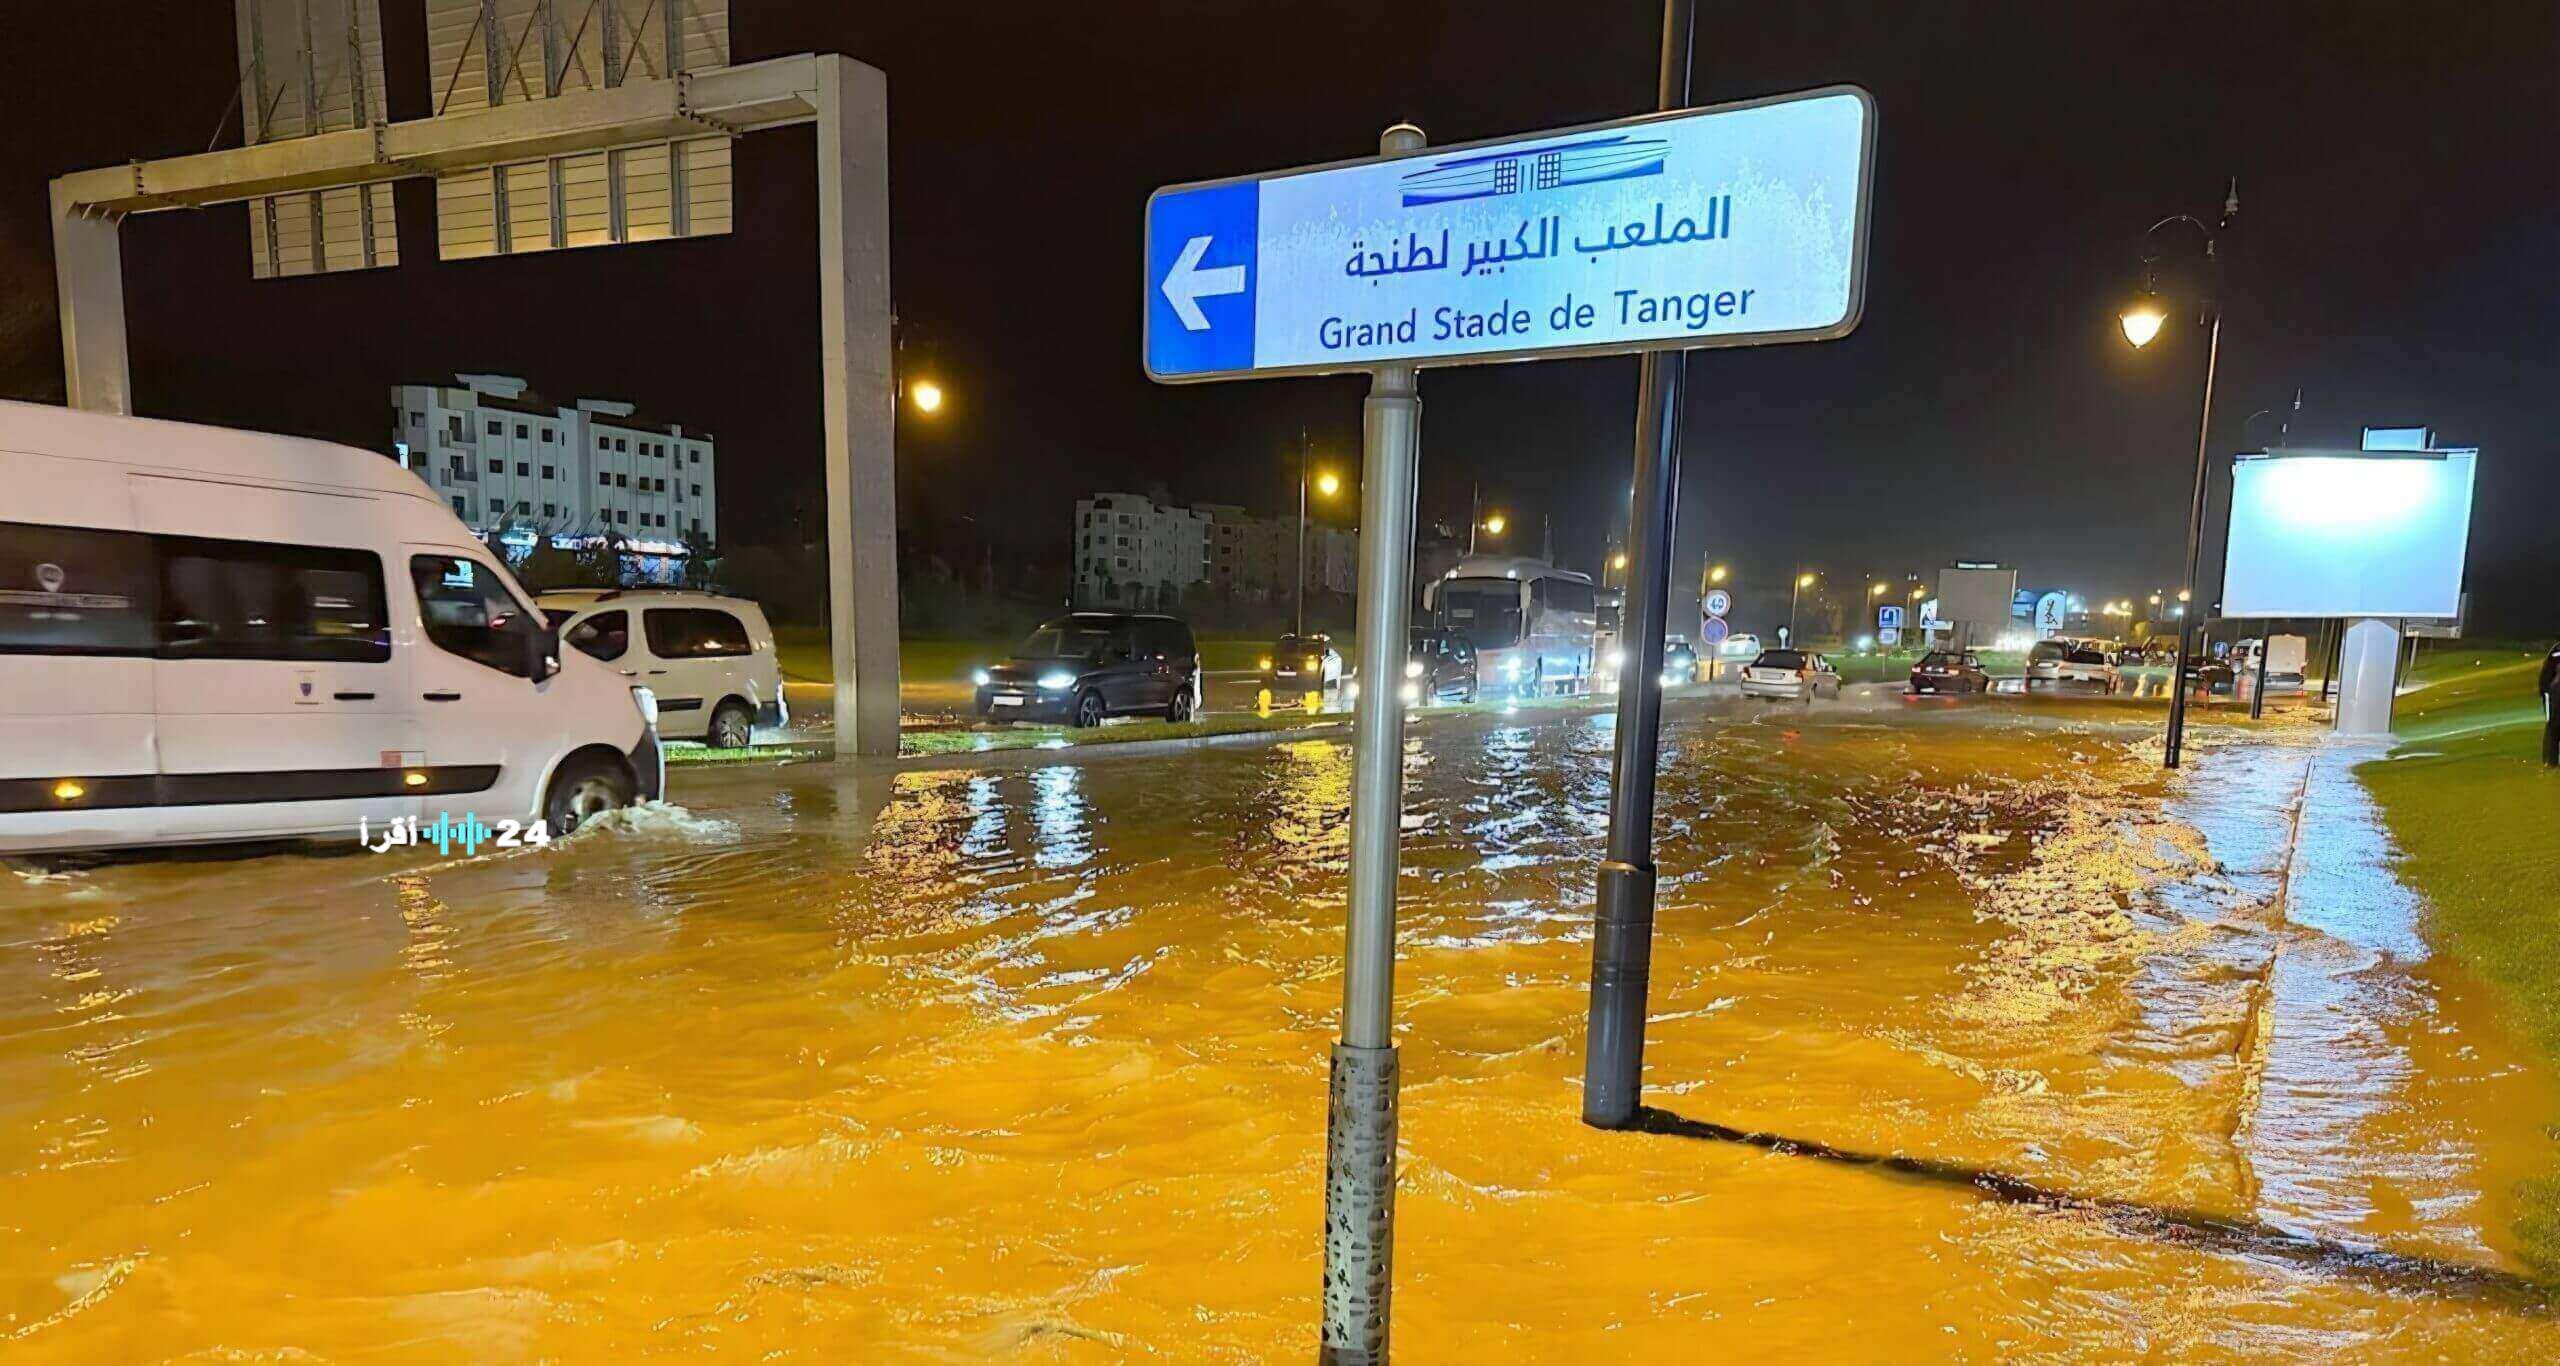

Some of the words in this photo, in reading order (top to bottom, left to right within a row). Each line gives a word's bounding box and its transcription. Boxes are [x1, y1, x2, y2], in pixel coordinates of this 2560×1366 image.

[1346, 229, 1449, 287] لطنجة
[1461, 215, 1559, 277] الكبير
[1575, 195, 1731, 263] الملعب
[1319, 308, 1416, 350] Grand
[1433, 299, 1531, 340] Stade
[1550, 293, 1595, 331] de
[1614, 289, 1755, 330] Tanger
